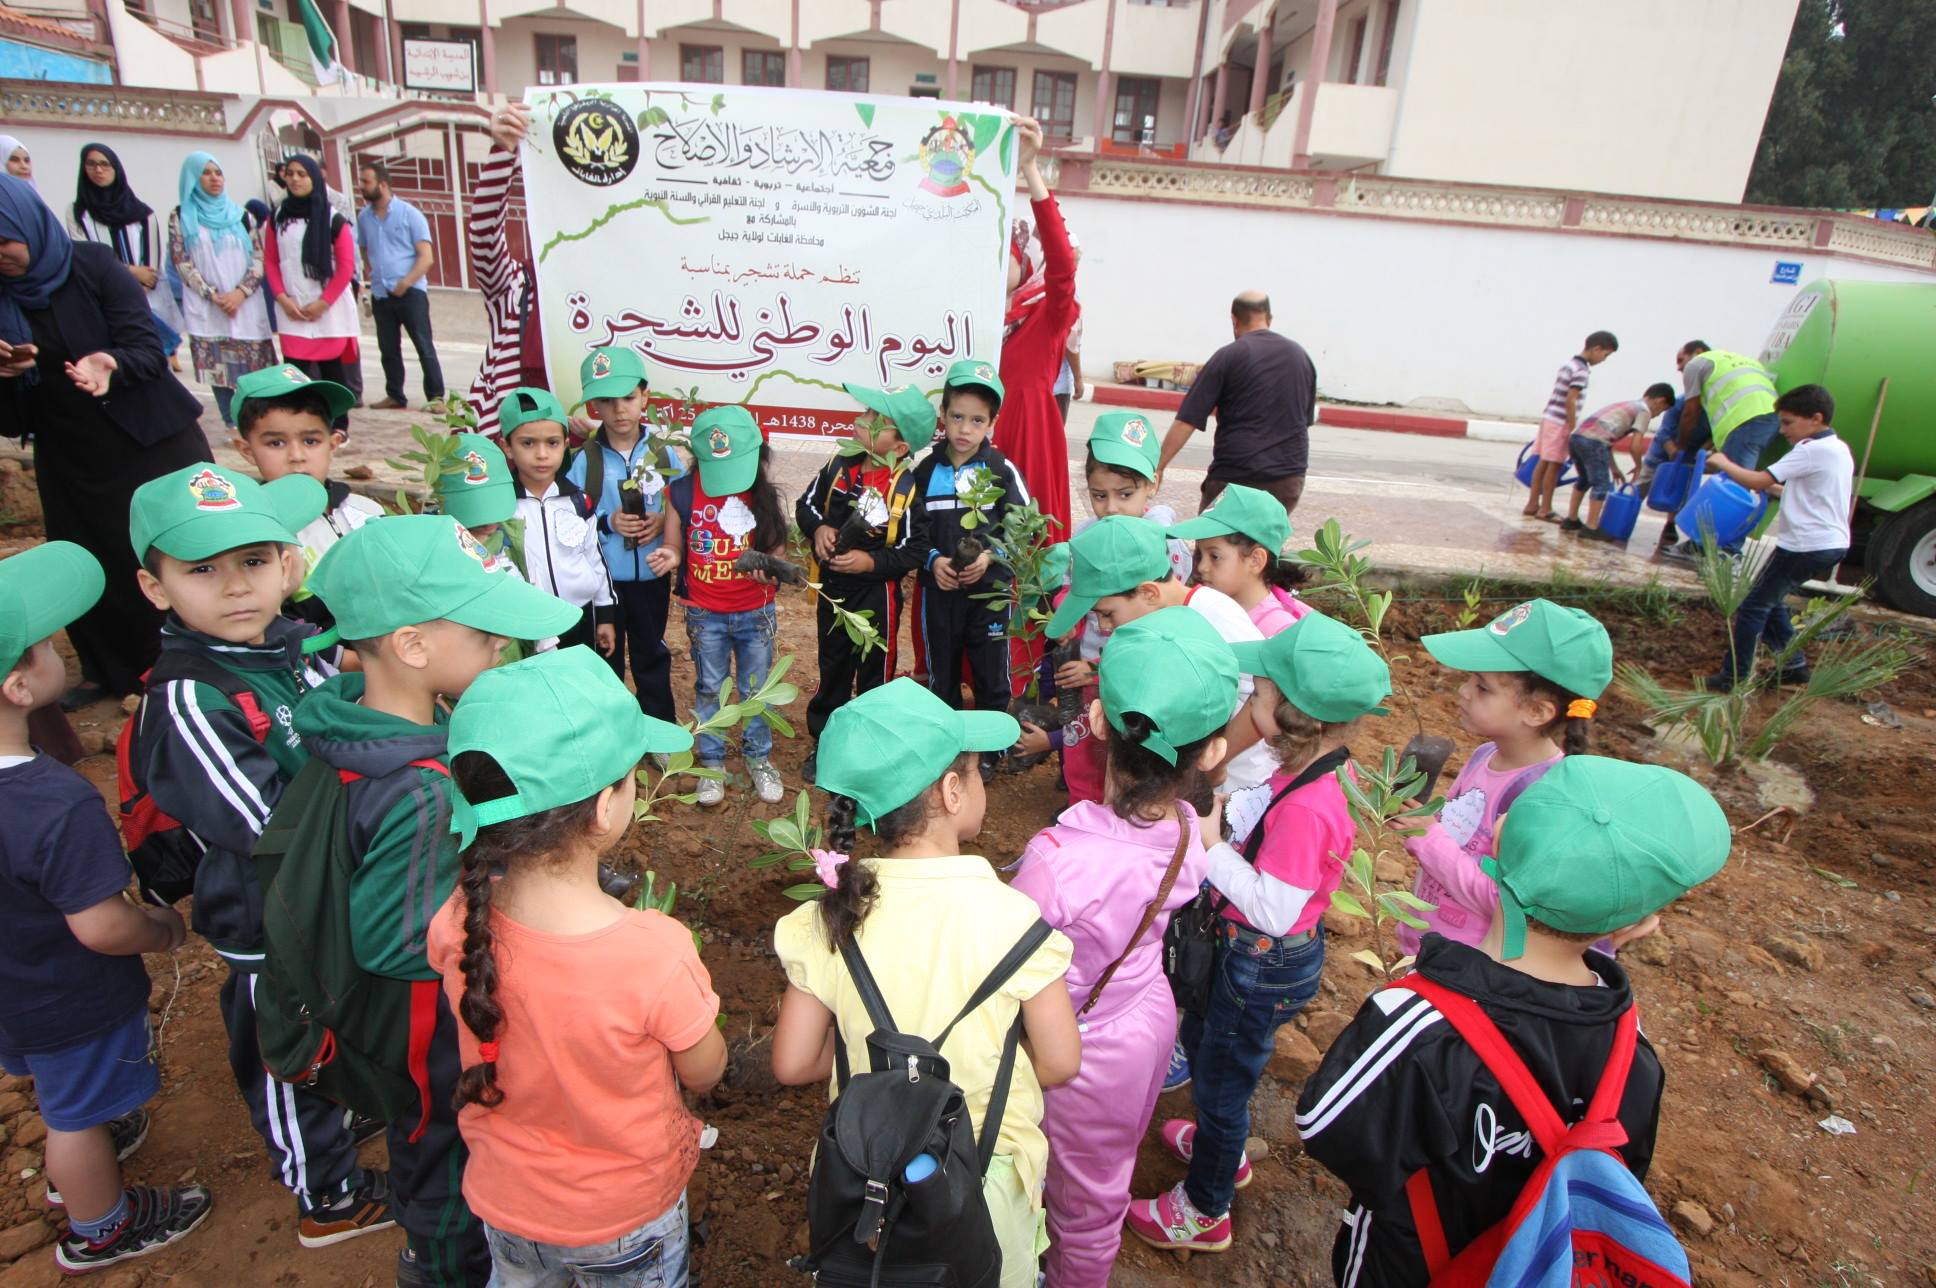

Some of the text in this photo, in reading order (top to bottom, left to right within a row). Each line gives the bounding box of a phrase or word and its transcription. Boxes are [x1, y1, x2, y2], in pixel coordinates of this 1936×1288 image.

[754, 179, 782, 190] تربوية
[669, 190, 697, 204] والسنة
[723, 195, 748, 209] التعليم
[749, 198, 766, 210] لجنة
[758, 213, 797, 227] بالمشاركة
[718, 228, 825, 247] محافظة الغابات لولاية جيجل
[680, 254, 861, 286] تنظم حملة تشجير بمناسبة
[568, 292, 972, 384] اليوم الوطني للشجرة
[820, 420, 855, 436] محرم
